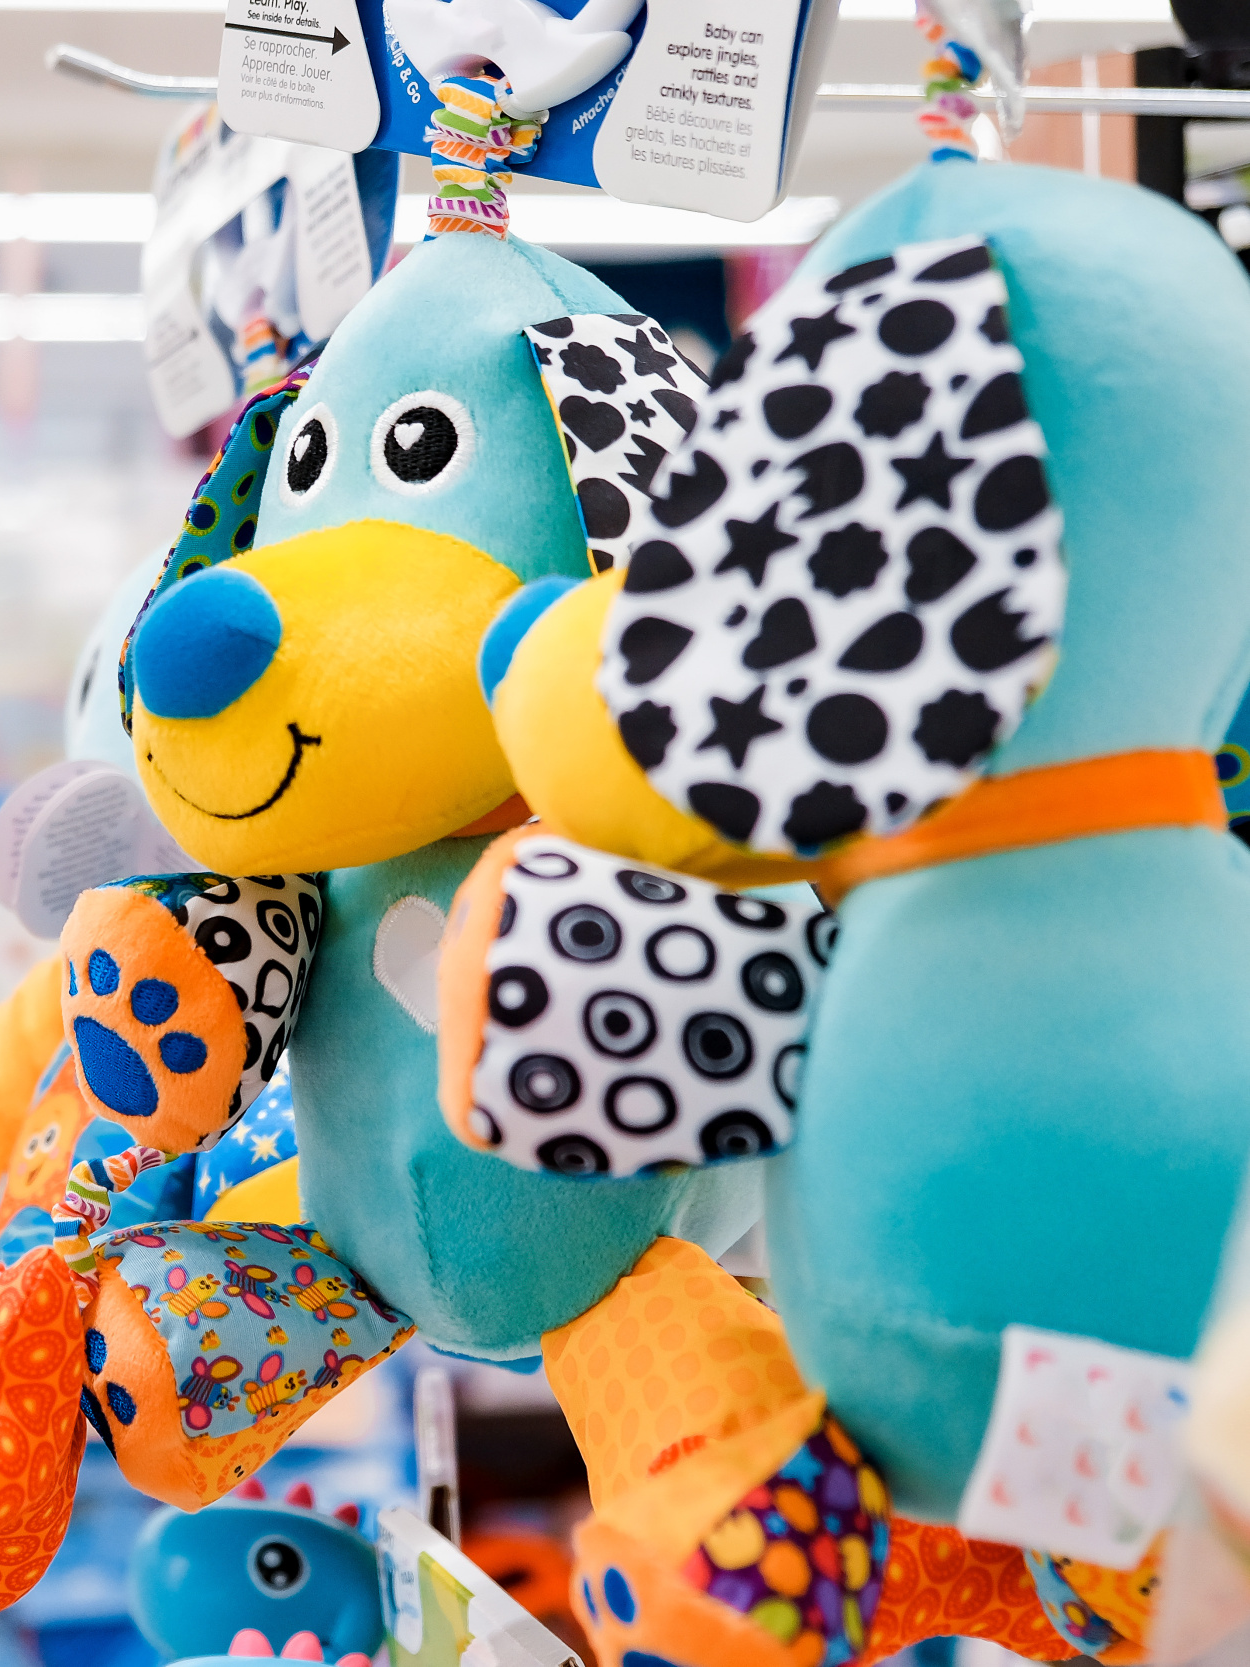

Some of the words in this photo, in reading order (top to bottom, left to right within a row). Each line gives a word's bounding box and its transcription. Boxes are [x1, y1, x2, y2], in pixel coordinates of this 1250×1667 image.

[247, 9, 261, 20] See
[262, 12, 282, 23] inside
[284, 14, 294, 24] for
[295, 16, 321, 29] details.
[284, 0, 309, 15] Play.
[704, 22, 737, 44] Baby
[740, 29, 764, 45] can
[244, 35, 256, 50] Se
[258, 40, 318, 60] rapprocher.
[667, 42, 713, 61] explore
[715, 47, 760, 68] jingles,
[242, 55, 298, 77] Apprendre.
[301, 64, 333, 82] Jouer.
[390, 38, 405, 67] Clip
[400, 67, 412, 84] &
[406, 81, 421, 104] Go
[691, 67, 730, 85] rattles
[733, 72, 759, 89] and
[241, 73, 253, 84] Voir
[255, 75, 261, 86] le
[262, 77, 277, 88] côté
[279, 78, 288, 89] de
[289, 80, 296, 91] la
[298, 81, 316, 94] boîte
[241, 88, 257, 99] pour
[258, 90, 273, 102] plus
[274, 92, 326, 110] d'informations.
[660, 83, 699, 106] crinkly
[702, 89, 755, 111] textures.
[572, 87, 616, 135] Attache
[646, 105, 676, 122] Bébé
[678, 109, 733, 133] découvre
[736, 121, 753, 137] les
[625, 125, 667, 147] grelots,
[670, 130, 687, 148] les
[689, 132, 736, 154] hochets
[738, 143, 752, 158] et
[630, 144, 647, 162] les
[649, 147, 696, 171] textures
[697, 155, 748, 179] plissées.
